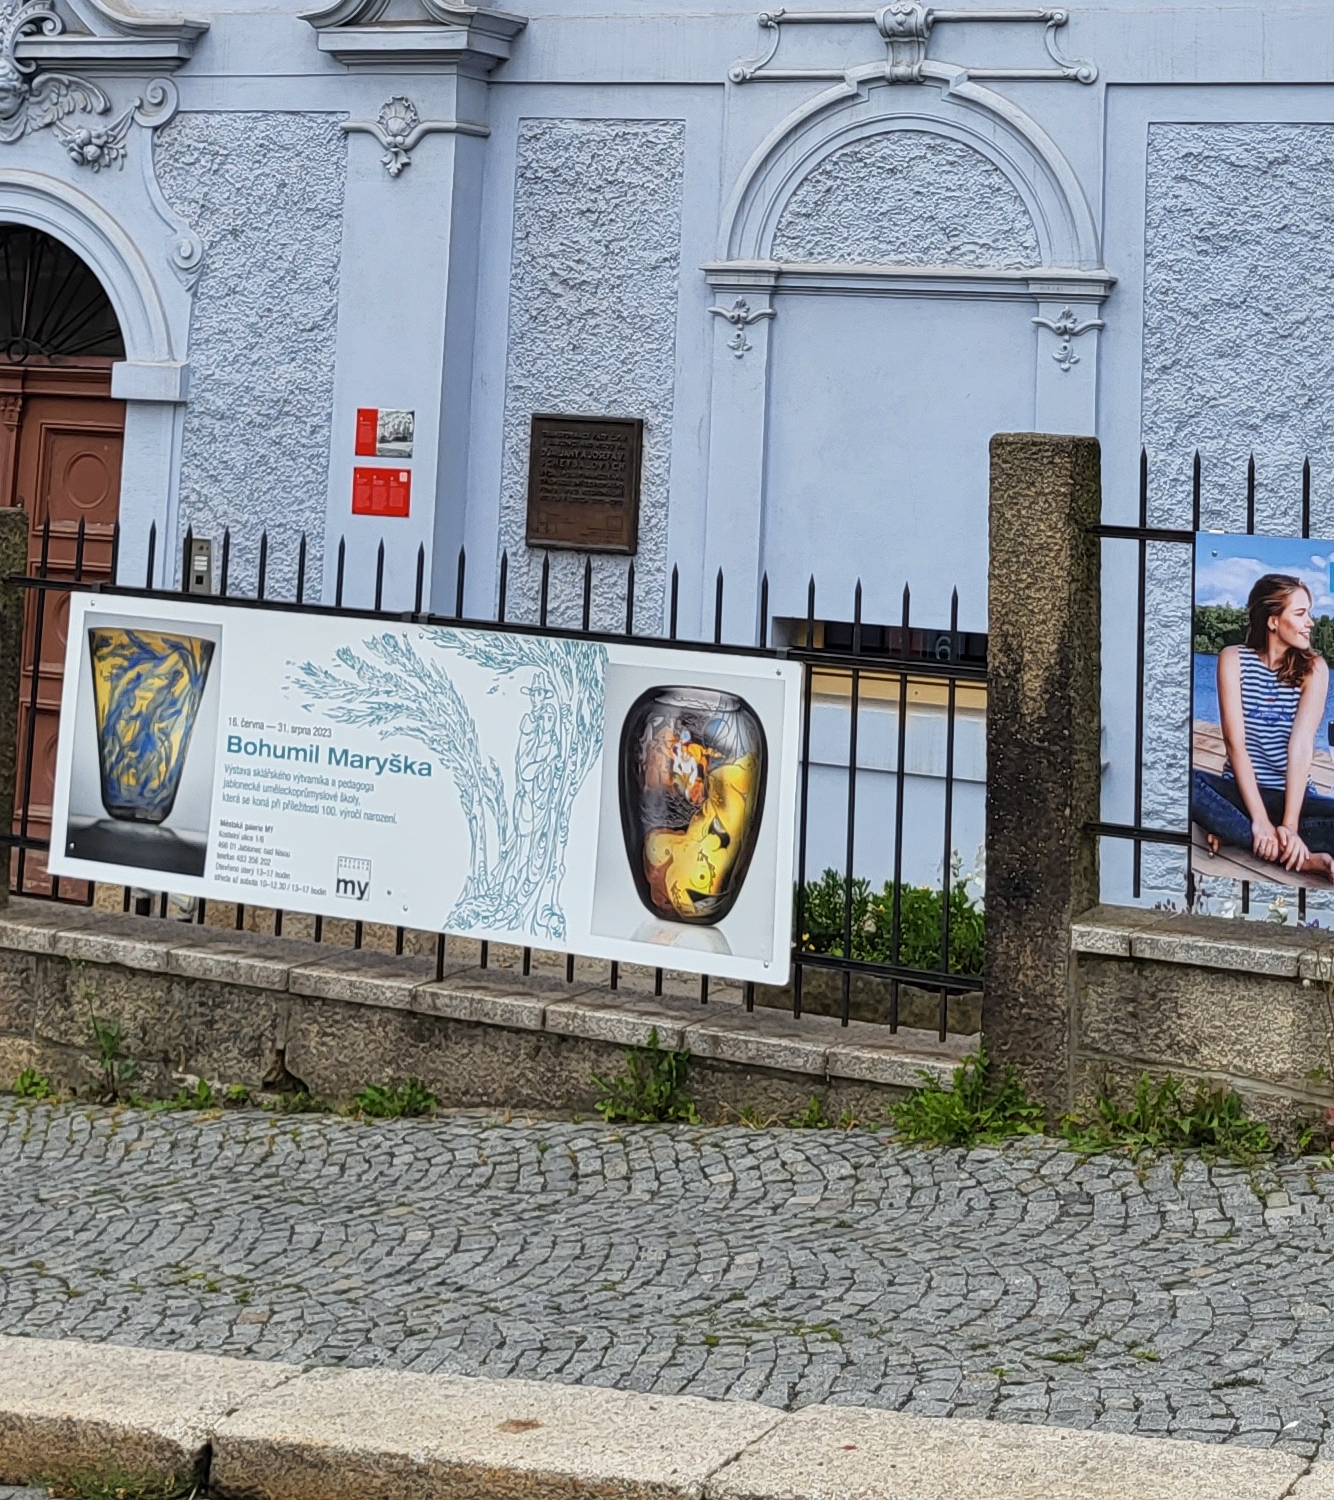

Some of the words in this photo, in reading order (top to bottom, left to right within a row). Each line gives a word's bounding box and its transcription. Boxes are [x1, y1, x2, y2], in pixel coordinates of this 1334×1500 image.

[228, 716, 238, 728] 16.
[240, 719, 264, 730] června
[277, 722, 289, 734] 31.
[291, 726, 311, 738] srpna
[313, 726, 332, 738] 2023
[226, 735, 320, 764] Bohumil
[328, 747, 432, 777] Maryška
[224, 763, 251, 777] Výstava
[338, 778, 374, 793] pedagoga
[242, 796, 250, 805] se
[252, 795, 268, 808] koná
[321, 805, 337, 817] 100.
[340, 807, 362, 820] výročí
[336, 877, 369, 900] my
